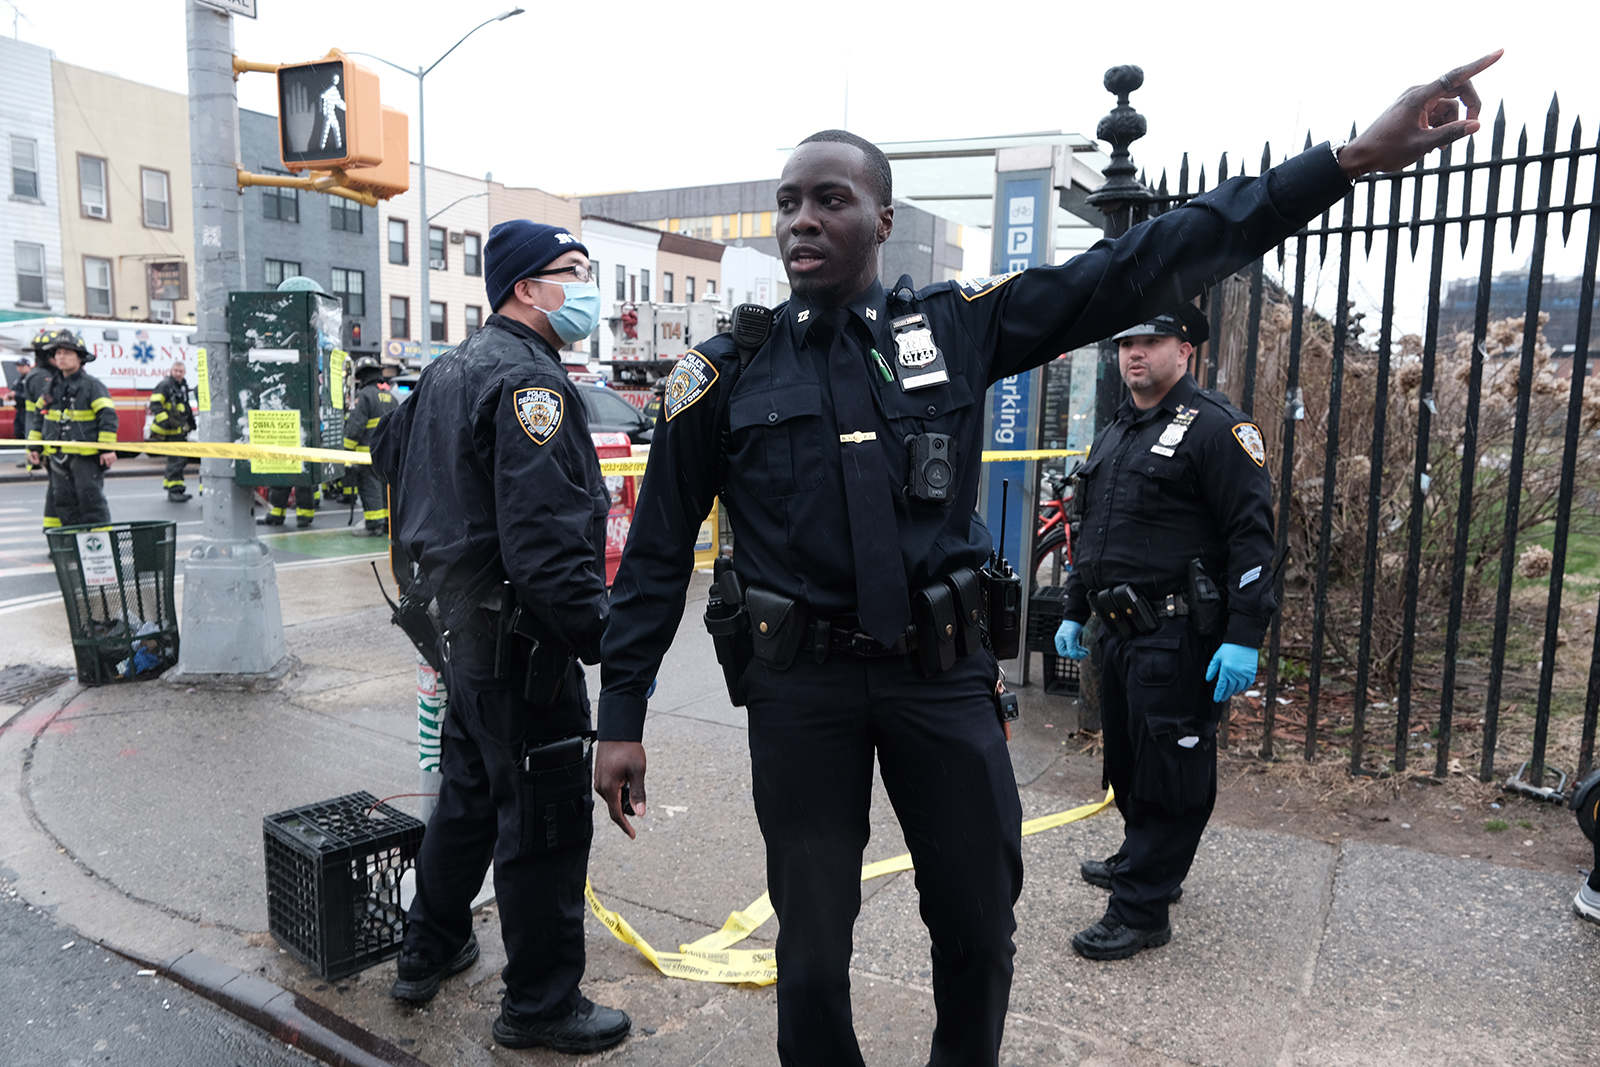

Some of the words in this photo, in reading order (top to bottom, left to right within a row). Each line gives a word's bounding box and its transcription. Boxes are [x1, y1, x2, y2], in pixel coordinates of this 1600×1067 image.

[1012, 231, 1028, 251] P
[748, 306, 765, 314] NYPD
[661, 322, 682, 340] 114
[685, 353, 706, 371] POLICE
[110, 367, 171, 377] AMBULANC
[682, 387, 703, 405] YORK
[994, 373, 1022, 444] arking
[752, 951, 775, 964] ROSS
[672, 962, 710, 976] stoppers
[717, 969, 777, 979] 1-800-577-TIP
